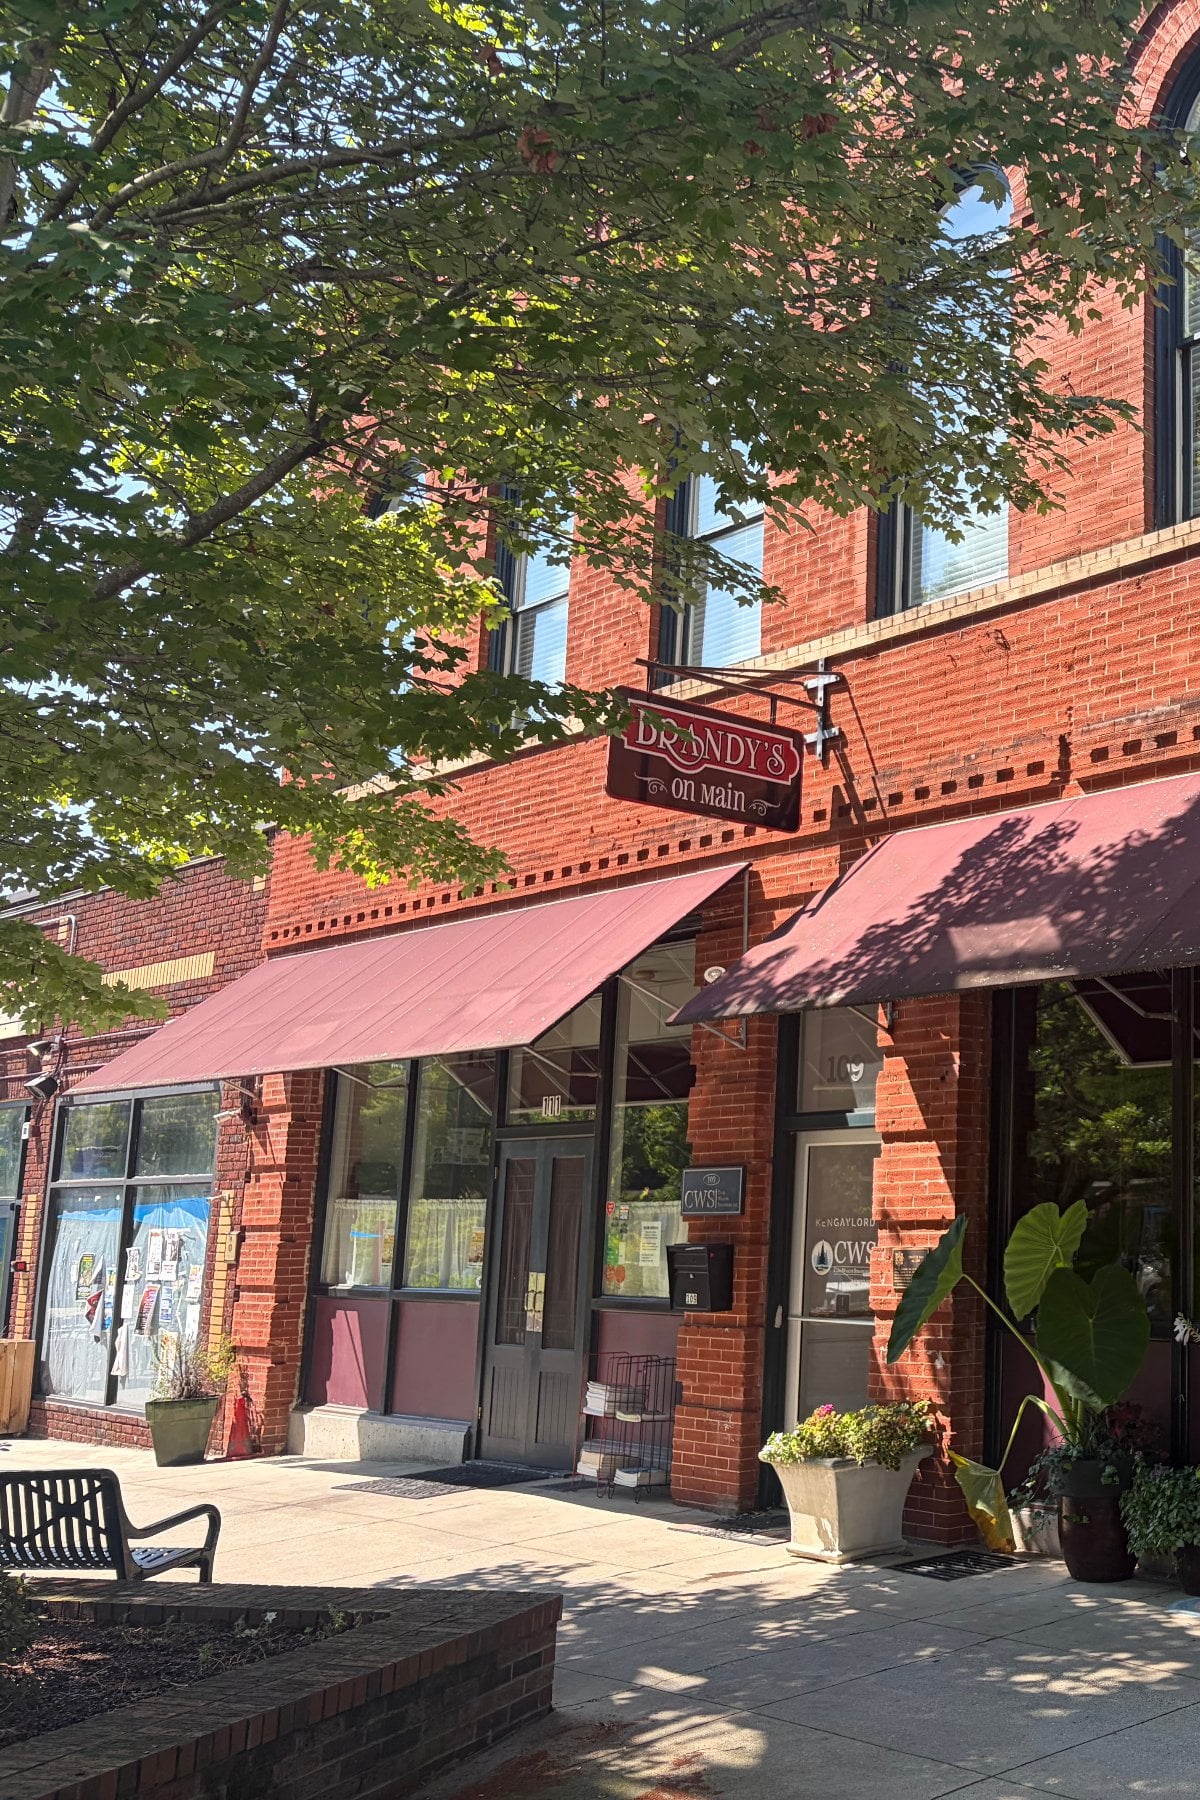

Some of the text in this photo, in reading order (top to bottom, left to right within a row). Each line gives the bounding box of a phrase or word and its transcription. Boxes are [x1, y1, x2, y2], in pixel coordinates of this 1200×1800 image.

[635, 707, 787, 776] BRANDY'S
[671, 776, 747, 813] on Main
[827, 1054, 865, 1083] 109
[543, 1096, 561, 1117] 111
[707, 1175, 717, 1184] 109
[684, 1190, 715, 1209] CWS
